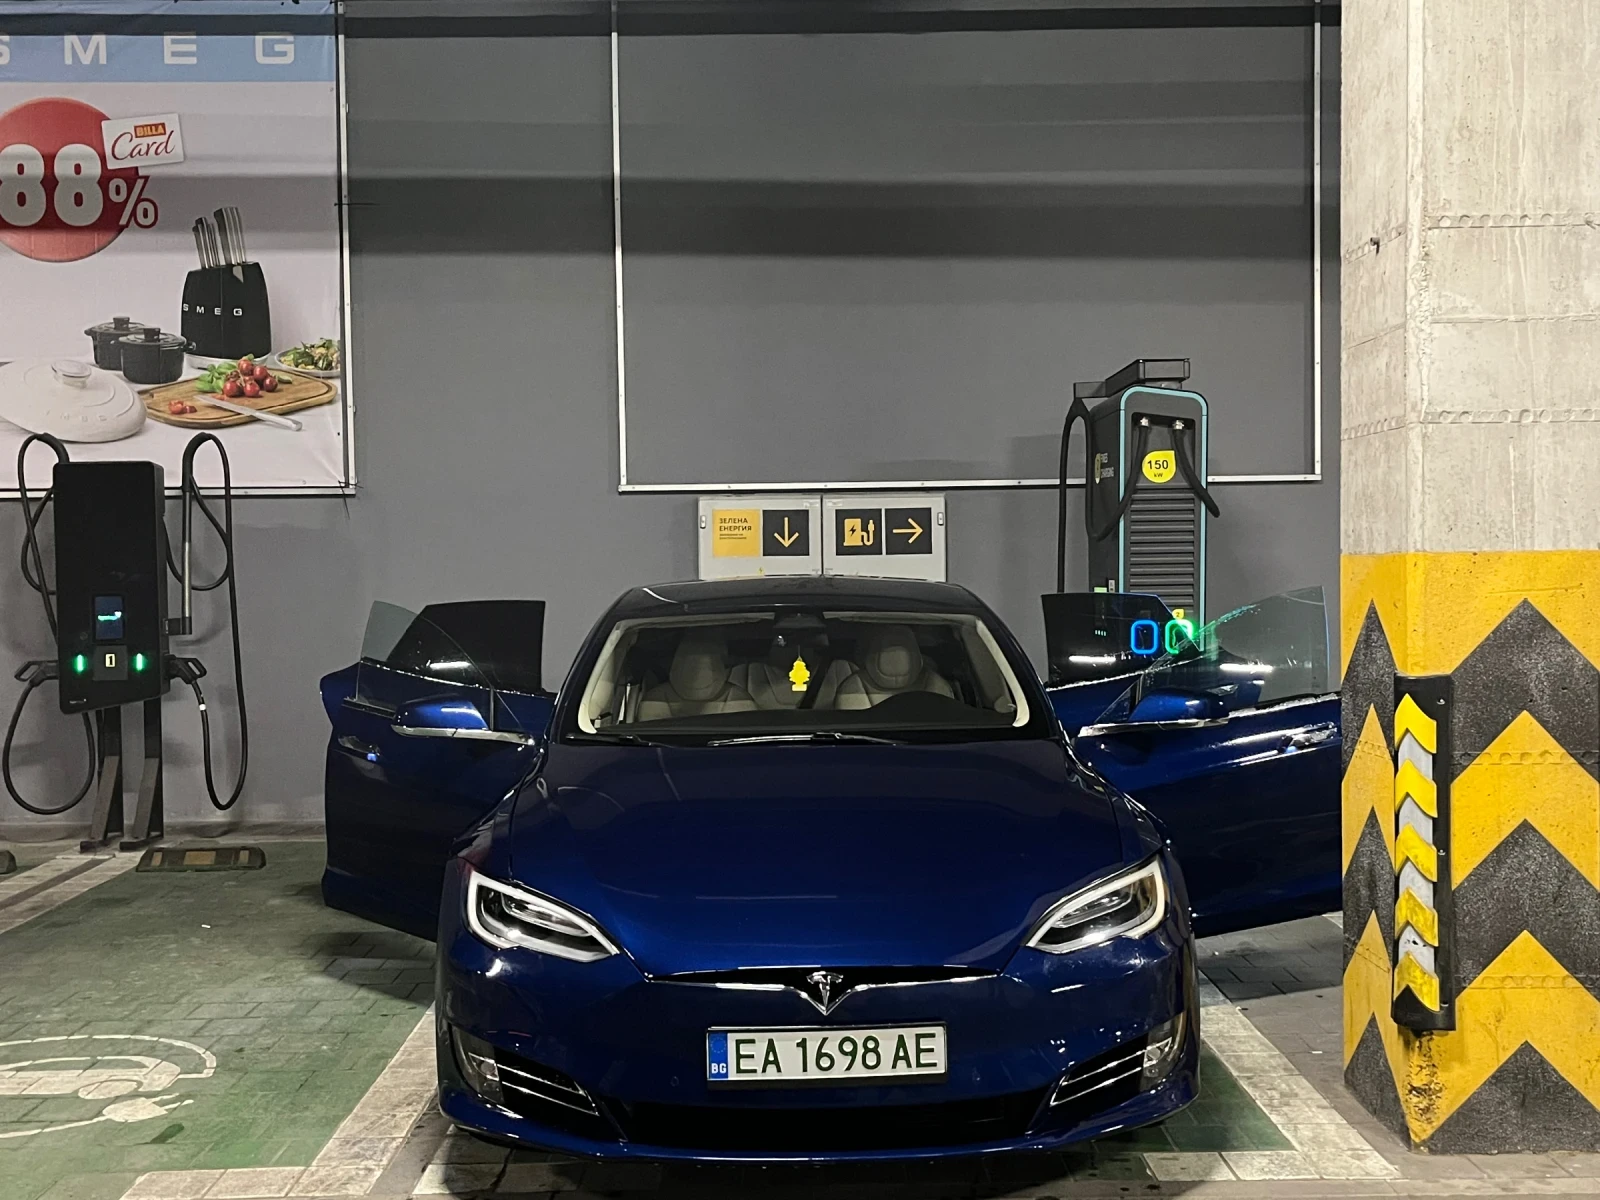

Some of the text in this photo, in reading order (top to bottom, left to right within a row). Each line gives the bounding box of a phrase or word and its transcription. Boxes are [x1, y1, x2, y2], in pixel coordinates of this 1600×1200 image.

[0, 32, 295, 65] MEG
[135, 124, 165, 137] BILLA
[111, 130, 175, 160] Card
[182, 303, 243, 316] SMEG
[1147, 459, 1169, 470] 150
[108, 655, 114, 666] 1
[735, 1033, 938, 1074] EA 1698 AE
[711, 1063, 727, 1074] BG
